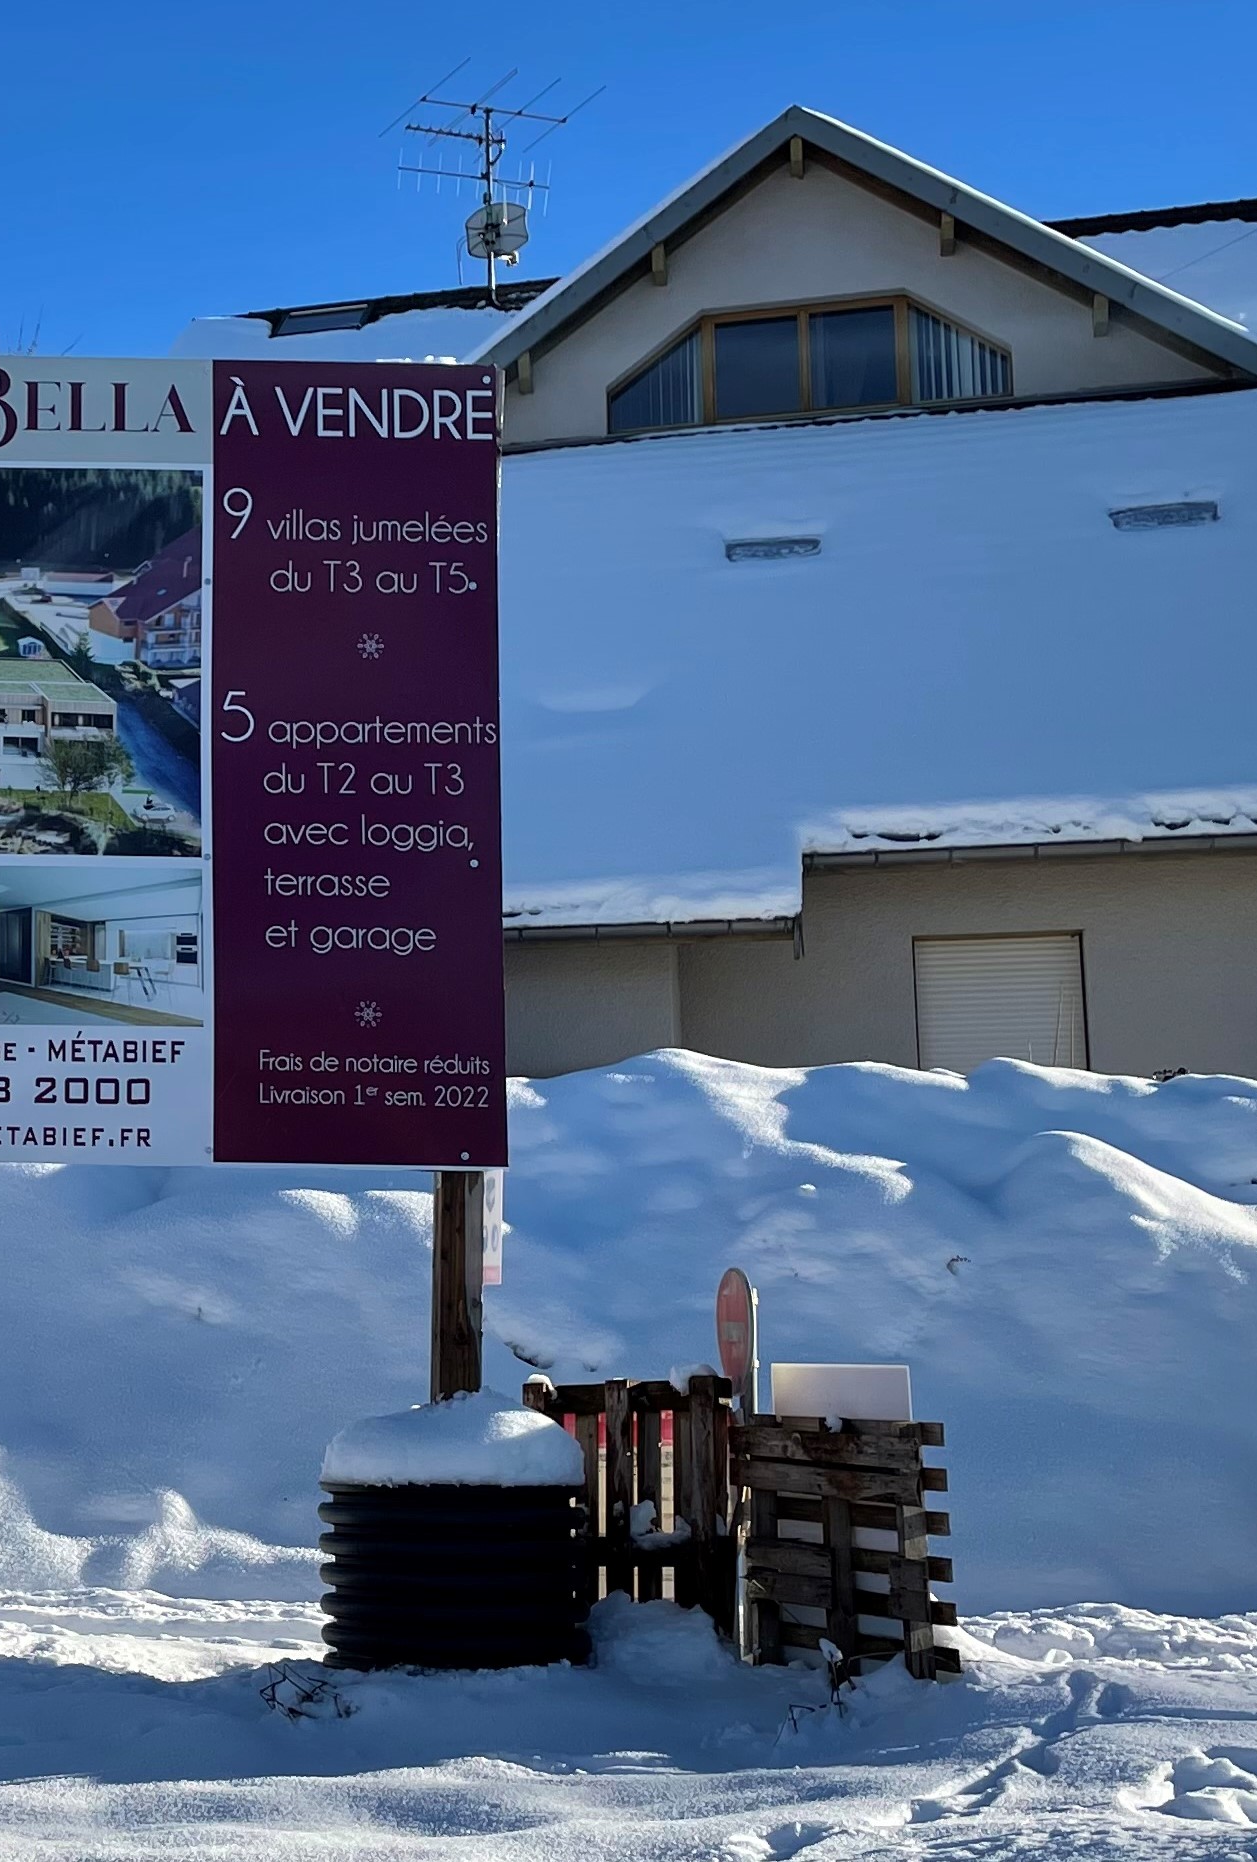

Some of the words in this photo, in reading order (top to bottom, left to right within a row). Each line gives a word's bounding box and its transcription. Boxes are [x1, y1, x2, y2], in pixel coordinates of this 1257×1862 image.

[220, 376, 259, 436] À
[275, 386, 493, 440] VENDRE
[223, 488, 253, 539] 9
[267, 509, 341, 541] villas
[350, 511, 488, 545] jumelées
[270, 561, 312, 593] du
[322, 561, 362, 593] T3
[376, 570, 418, 593] au
[221, 691, 255, 742] 5
[268, 716, 496, 749] appartements
[263, 763, 304, 794] du
[317, 763, 356, 794] T2
[370, 772, 412, 794] au
[424, 763, 464, 795] T3
[264, 823, 348, 845] avec
[362, 813, 474, 851] loggia,
[264, 868, 390, 897] terrasse
[265, 920, 298, 948] et
[310, 926, 436, 955] garage
[48, 1031, 185, 1064] MÉTABIEF
[259, 1050, 303, 1071] Frais
[310, 1051, 339, 1072] de
[346, 1054, 417, 1074] notaire
[424, 1054, 490, 1075] réduits
[34, 1077, 151, 1105] 2000
[259, 1083, 345, 1105] Livraison
[385, 1090, 425, 1106] sem.
[434, 1086, 489, 1107] 2022
